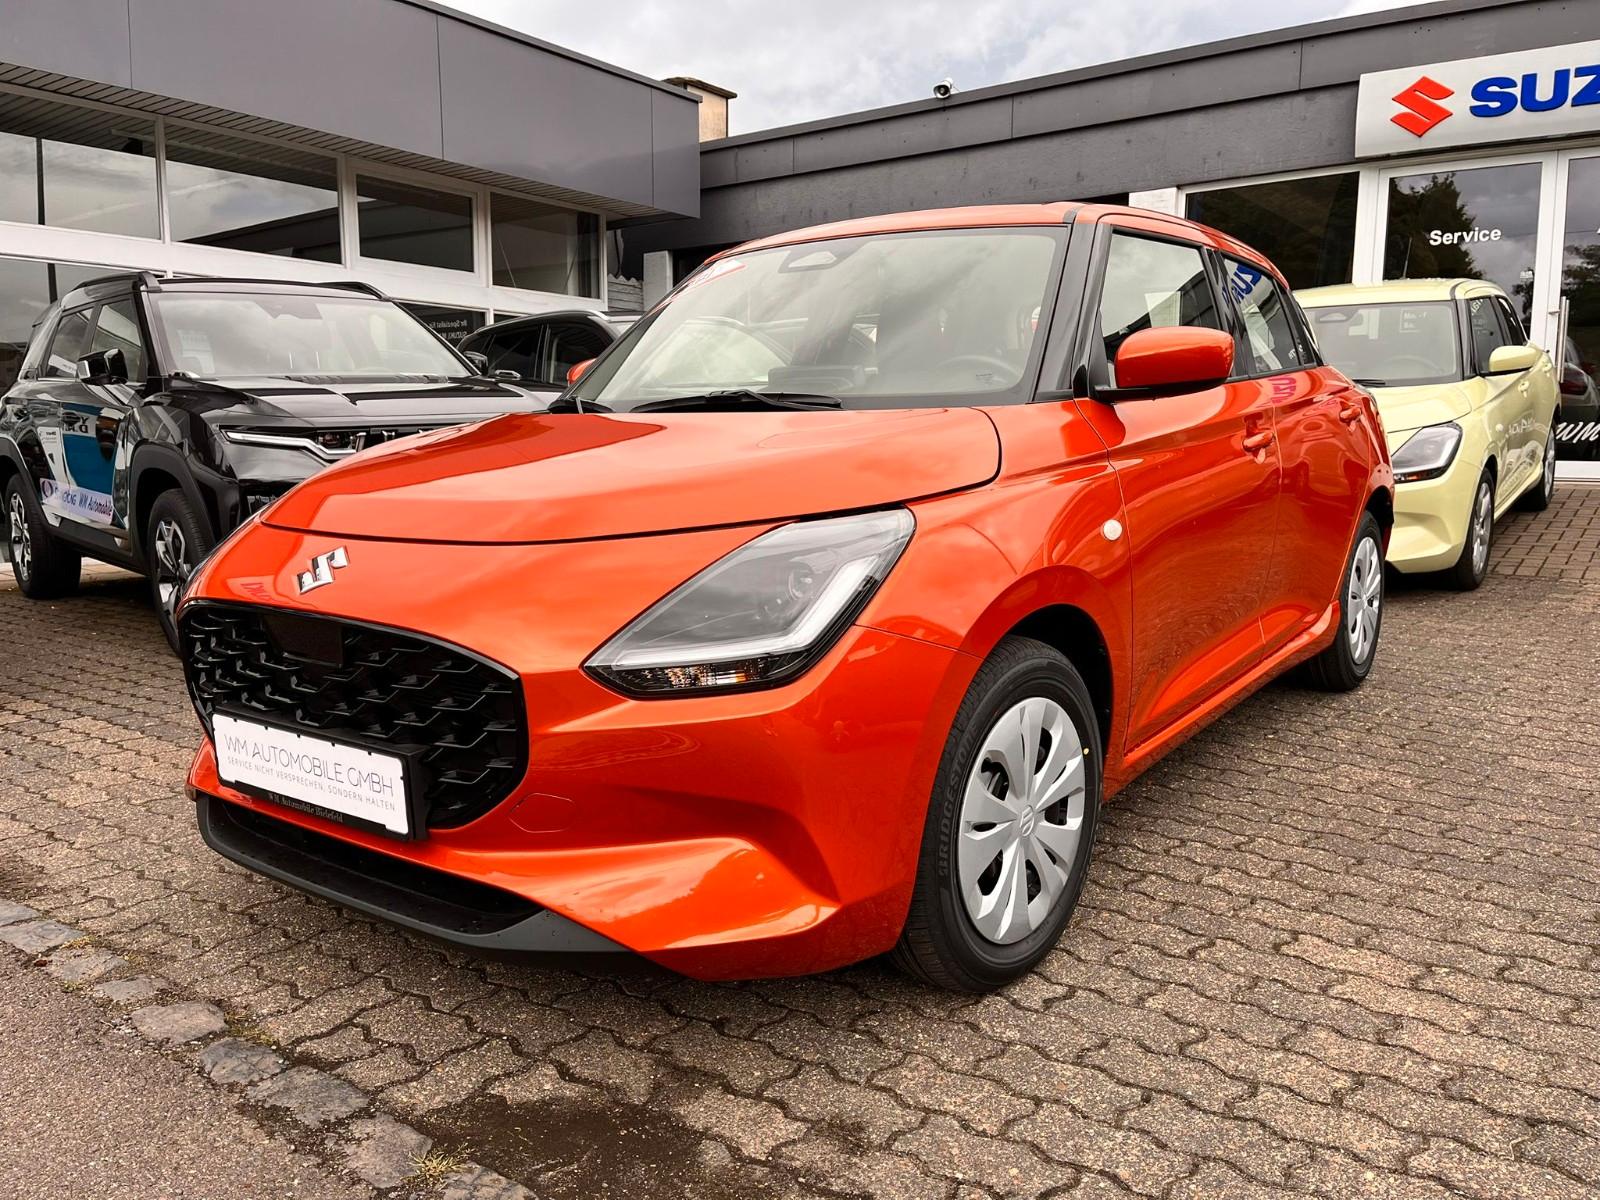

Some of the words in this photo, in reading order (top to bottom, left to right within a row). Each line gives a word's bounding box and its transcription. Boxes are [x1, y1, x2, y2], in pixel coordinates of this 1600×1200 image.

[1470, 64, 1600, 117] SUZ
[1429, 227, 1502, 246] Service
[87, 496, 113, 517] Automobile
[224, 734, 249, 756] WM
[252, 742, 344, 784] AUTOMOBILE
[347, 767, 394, 797] GMBH
[228, 756, 252, 770] SERVICE
[255, 765, 274, 776] NICHT
[327, 784, 363, 803] SONDERN
[365, 796, 396, 812] HALTEN
[280, 796, 315, 814] Automobile
[315, 807, 344, 823] Bielefeld
[938, 722, 979, 876] BRIDGESTONE
